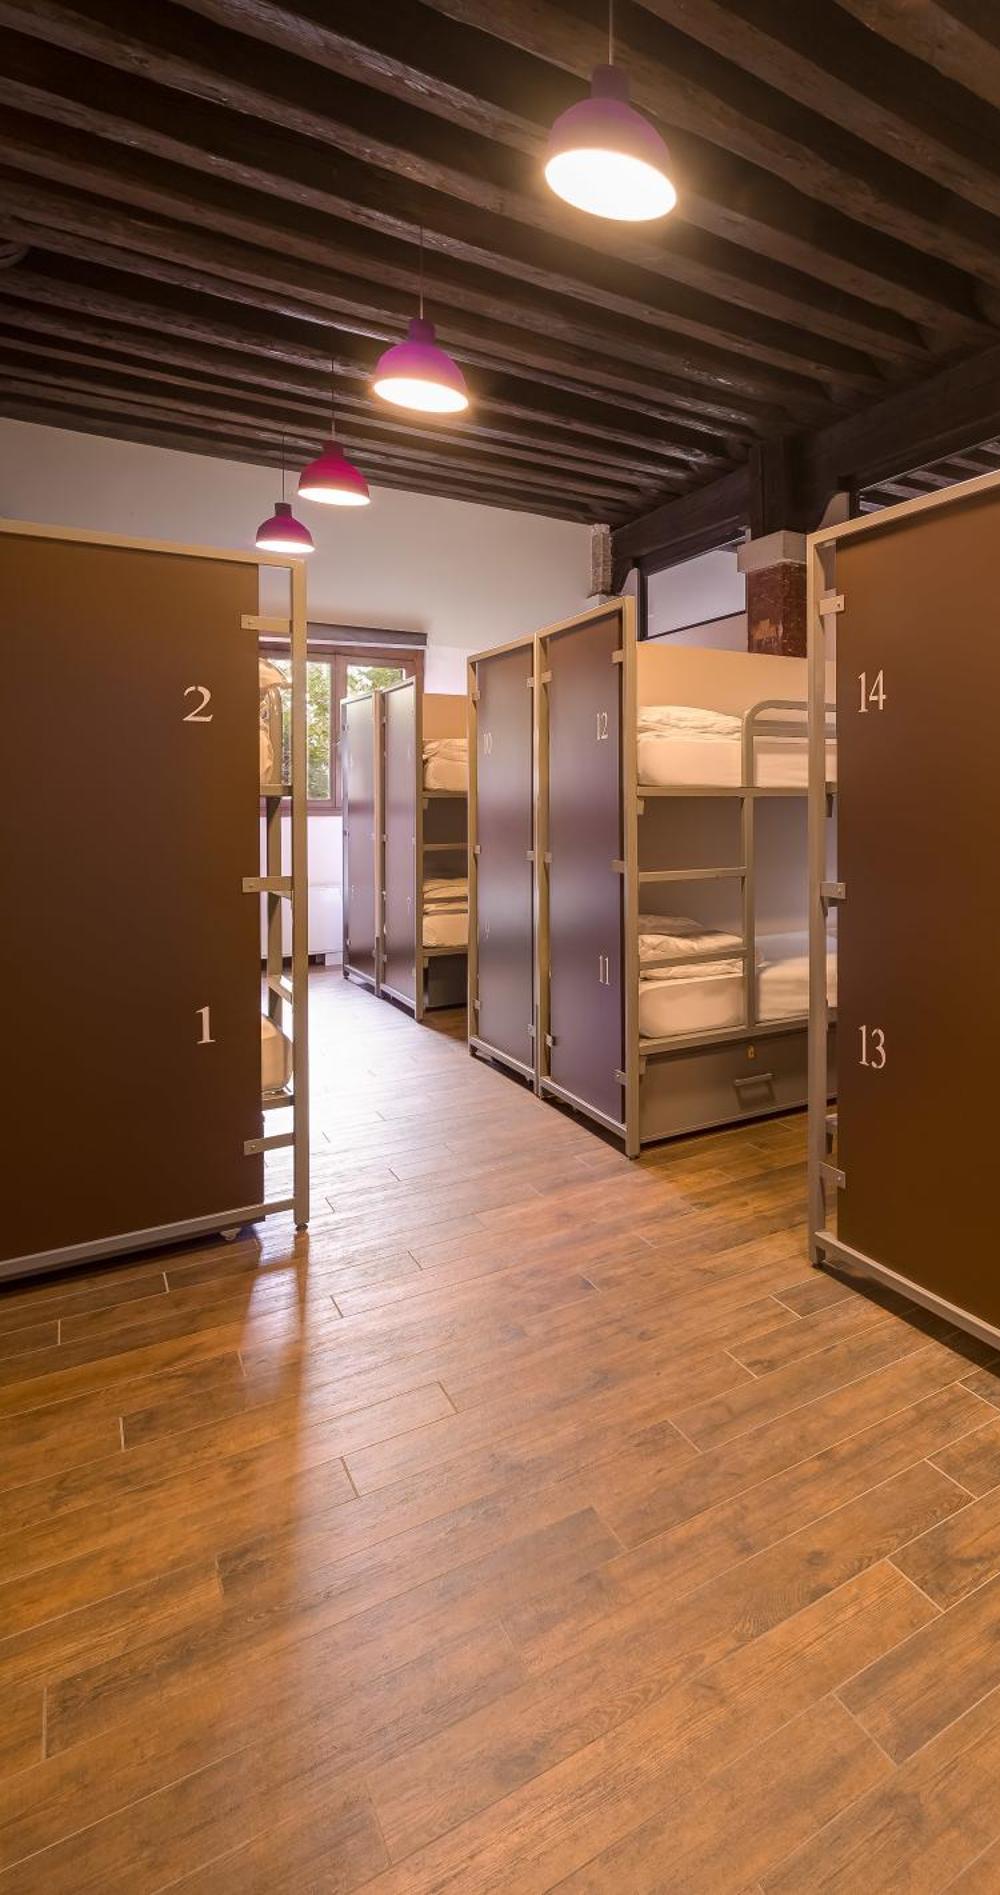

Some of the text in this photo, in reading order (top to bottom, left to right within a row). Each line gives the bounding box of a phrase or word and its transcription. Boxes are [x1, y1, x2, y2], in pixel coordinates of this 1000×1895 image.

[182, 685, 214, 722] 2
[858, 670, 886, 713] 14
[597, 712, 608, 740] 12
[196, 1006, 215, 1044] 1
[858, 1025, 887, 1069] 13
